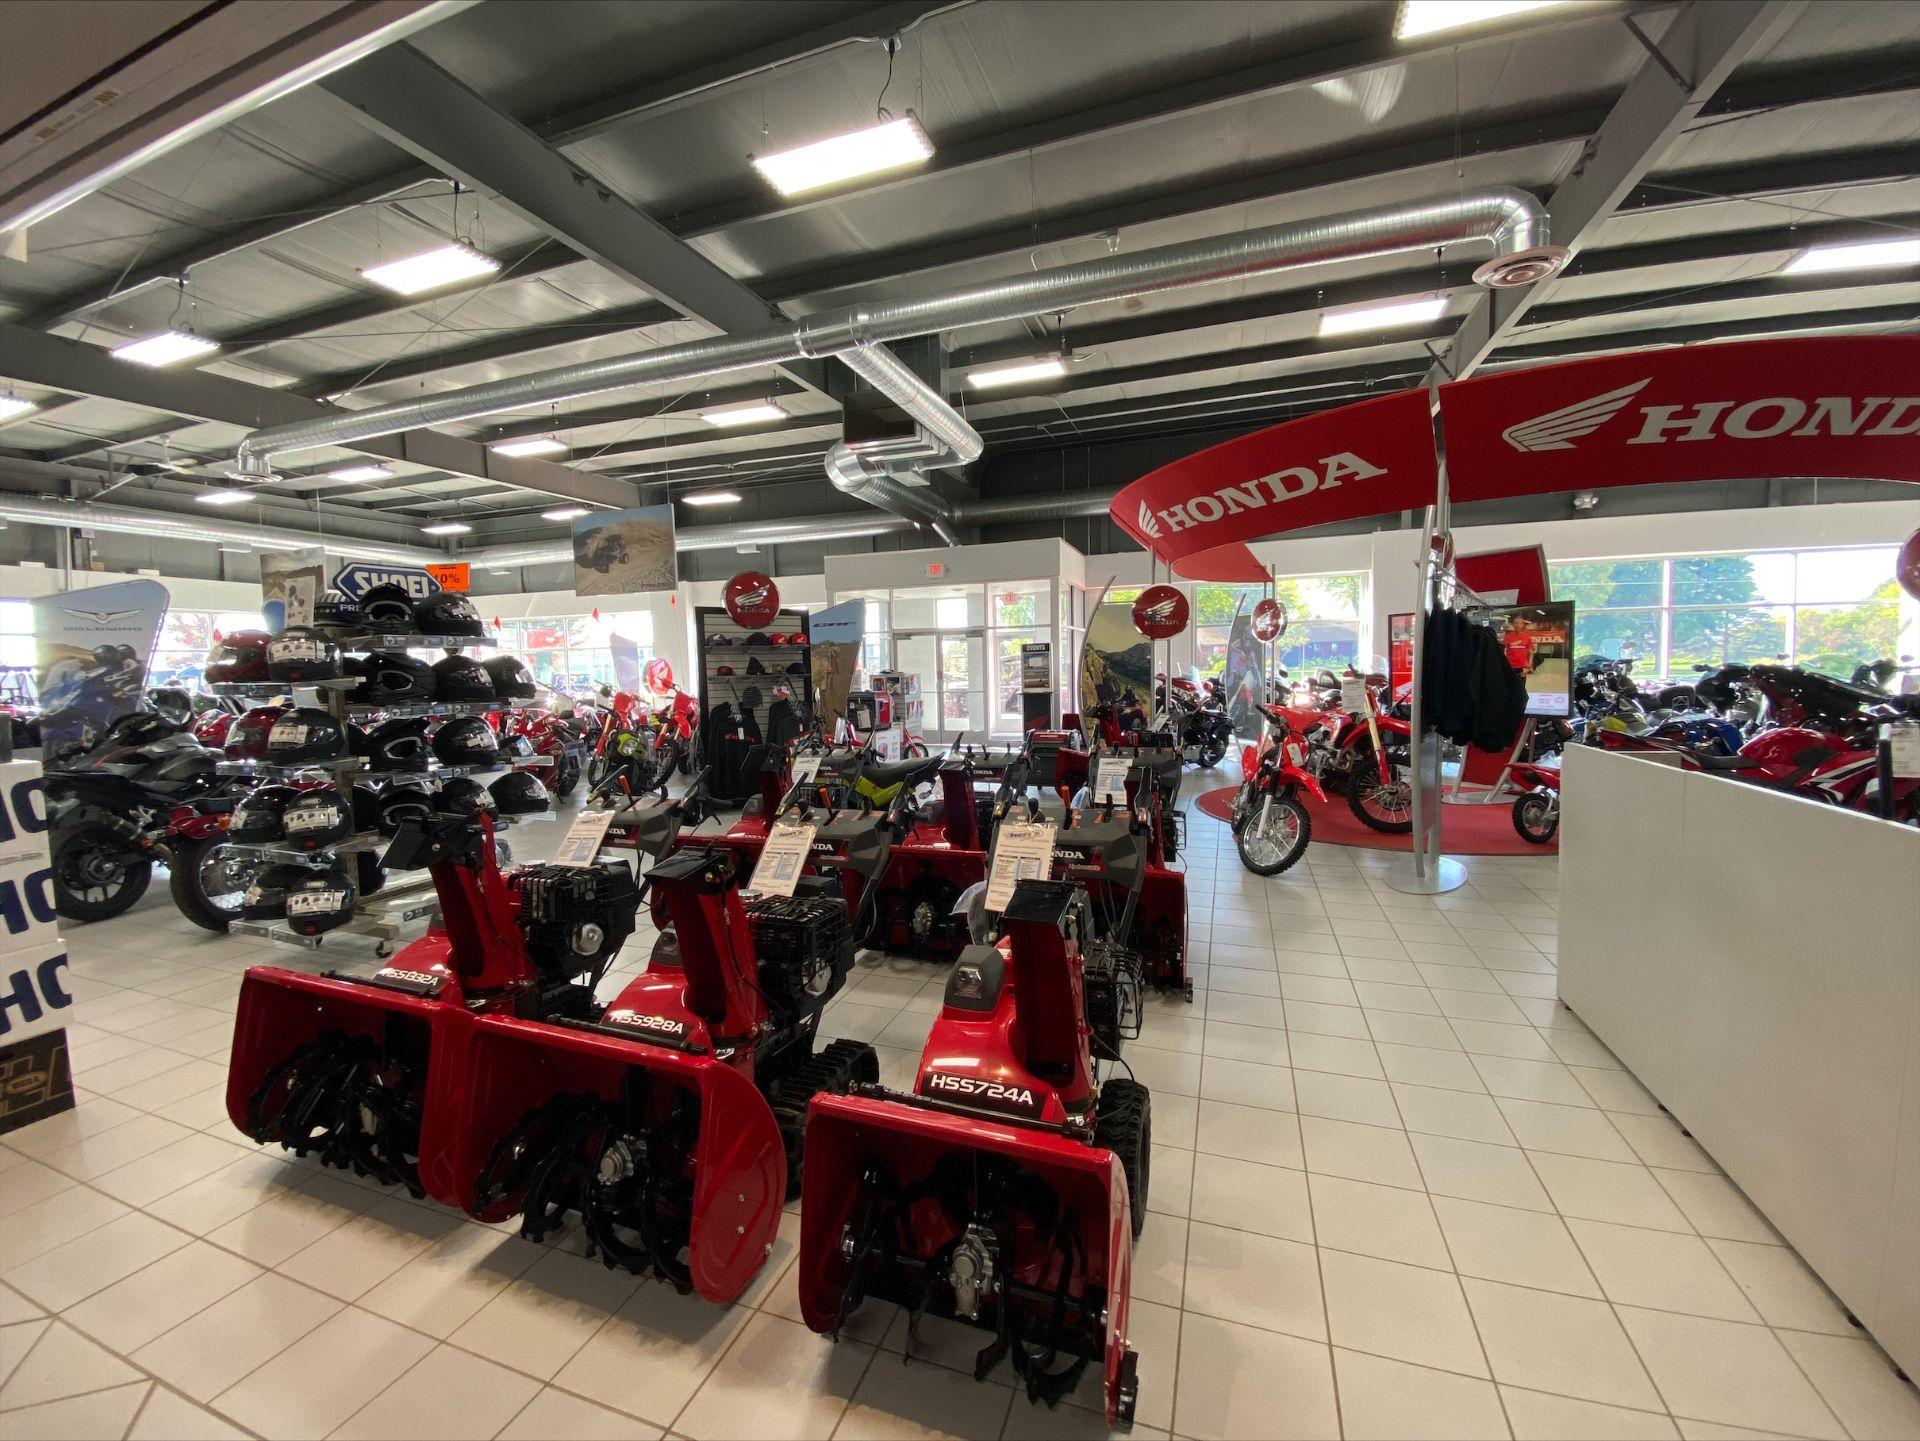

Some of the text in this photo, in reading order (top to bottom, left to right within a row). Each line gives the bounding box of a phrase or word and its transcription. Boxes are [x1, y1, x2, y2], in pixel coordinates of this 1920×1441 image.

[1157, 452, 1389, 532] HONDA
[1050, 850, 1085, 860] NDA
[930, 1074, 1034, 1106] HSS724A
